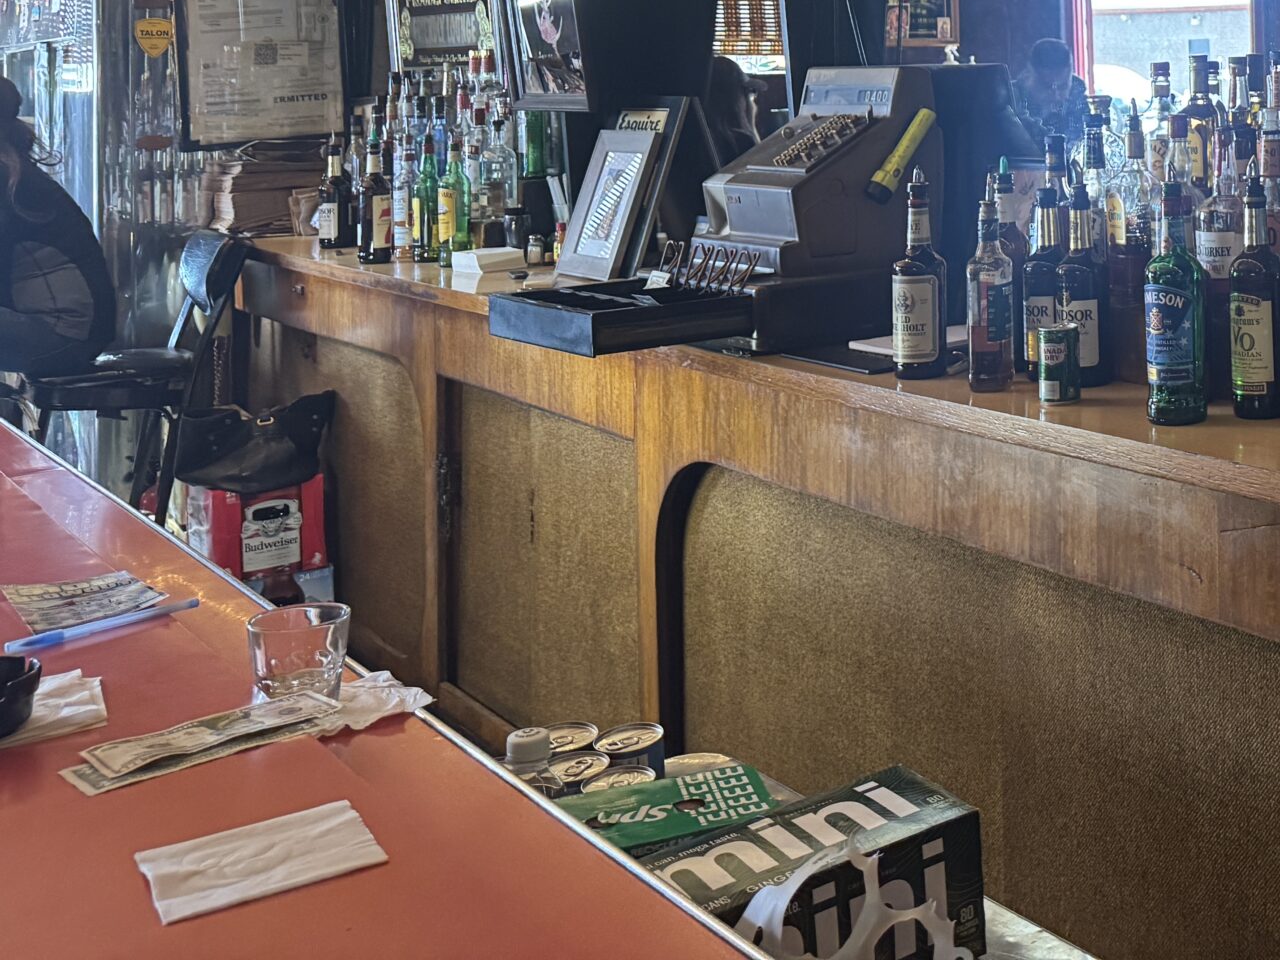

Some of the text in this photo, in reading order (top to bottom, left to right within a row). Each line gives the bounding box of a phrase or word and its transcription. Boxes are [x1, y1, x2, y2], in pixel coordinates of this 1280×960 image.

[139, 29, 169, 37] TALON
[273, 93, 328, 104] ERMITTED
[865, 91, 888, 103] 0400
[619, 113, 661, 132] Esquire
[1144, 291, 1184, 308] MESON
[1056, 308, 1094, 321] NDSOR
[244, 537, 298, 553] Budweiser
[300, 573, 310, 582] 24
[927, 794, 944, 804] 80
[653, 780, 921, 900] mini
[746, 870, 795, 893] GINGE
[960, 905, 975, 922] 80
